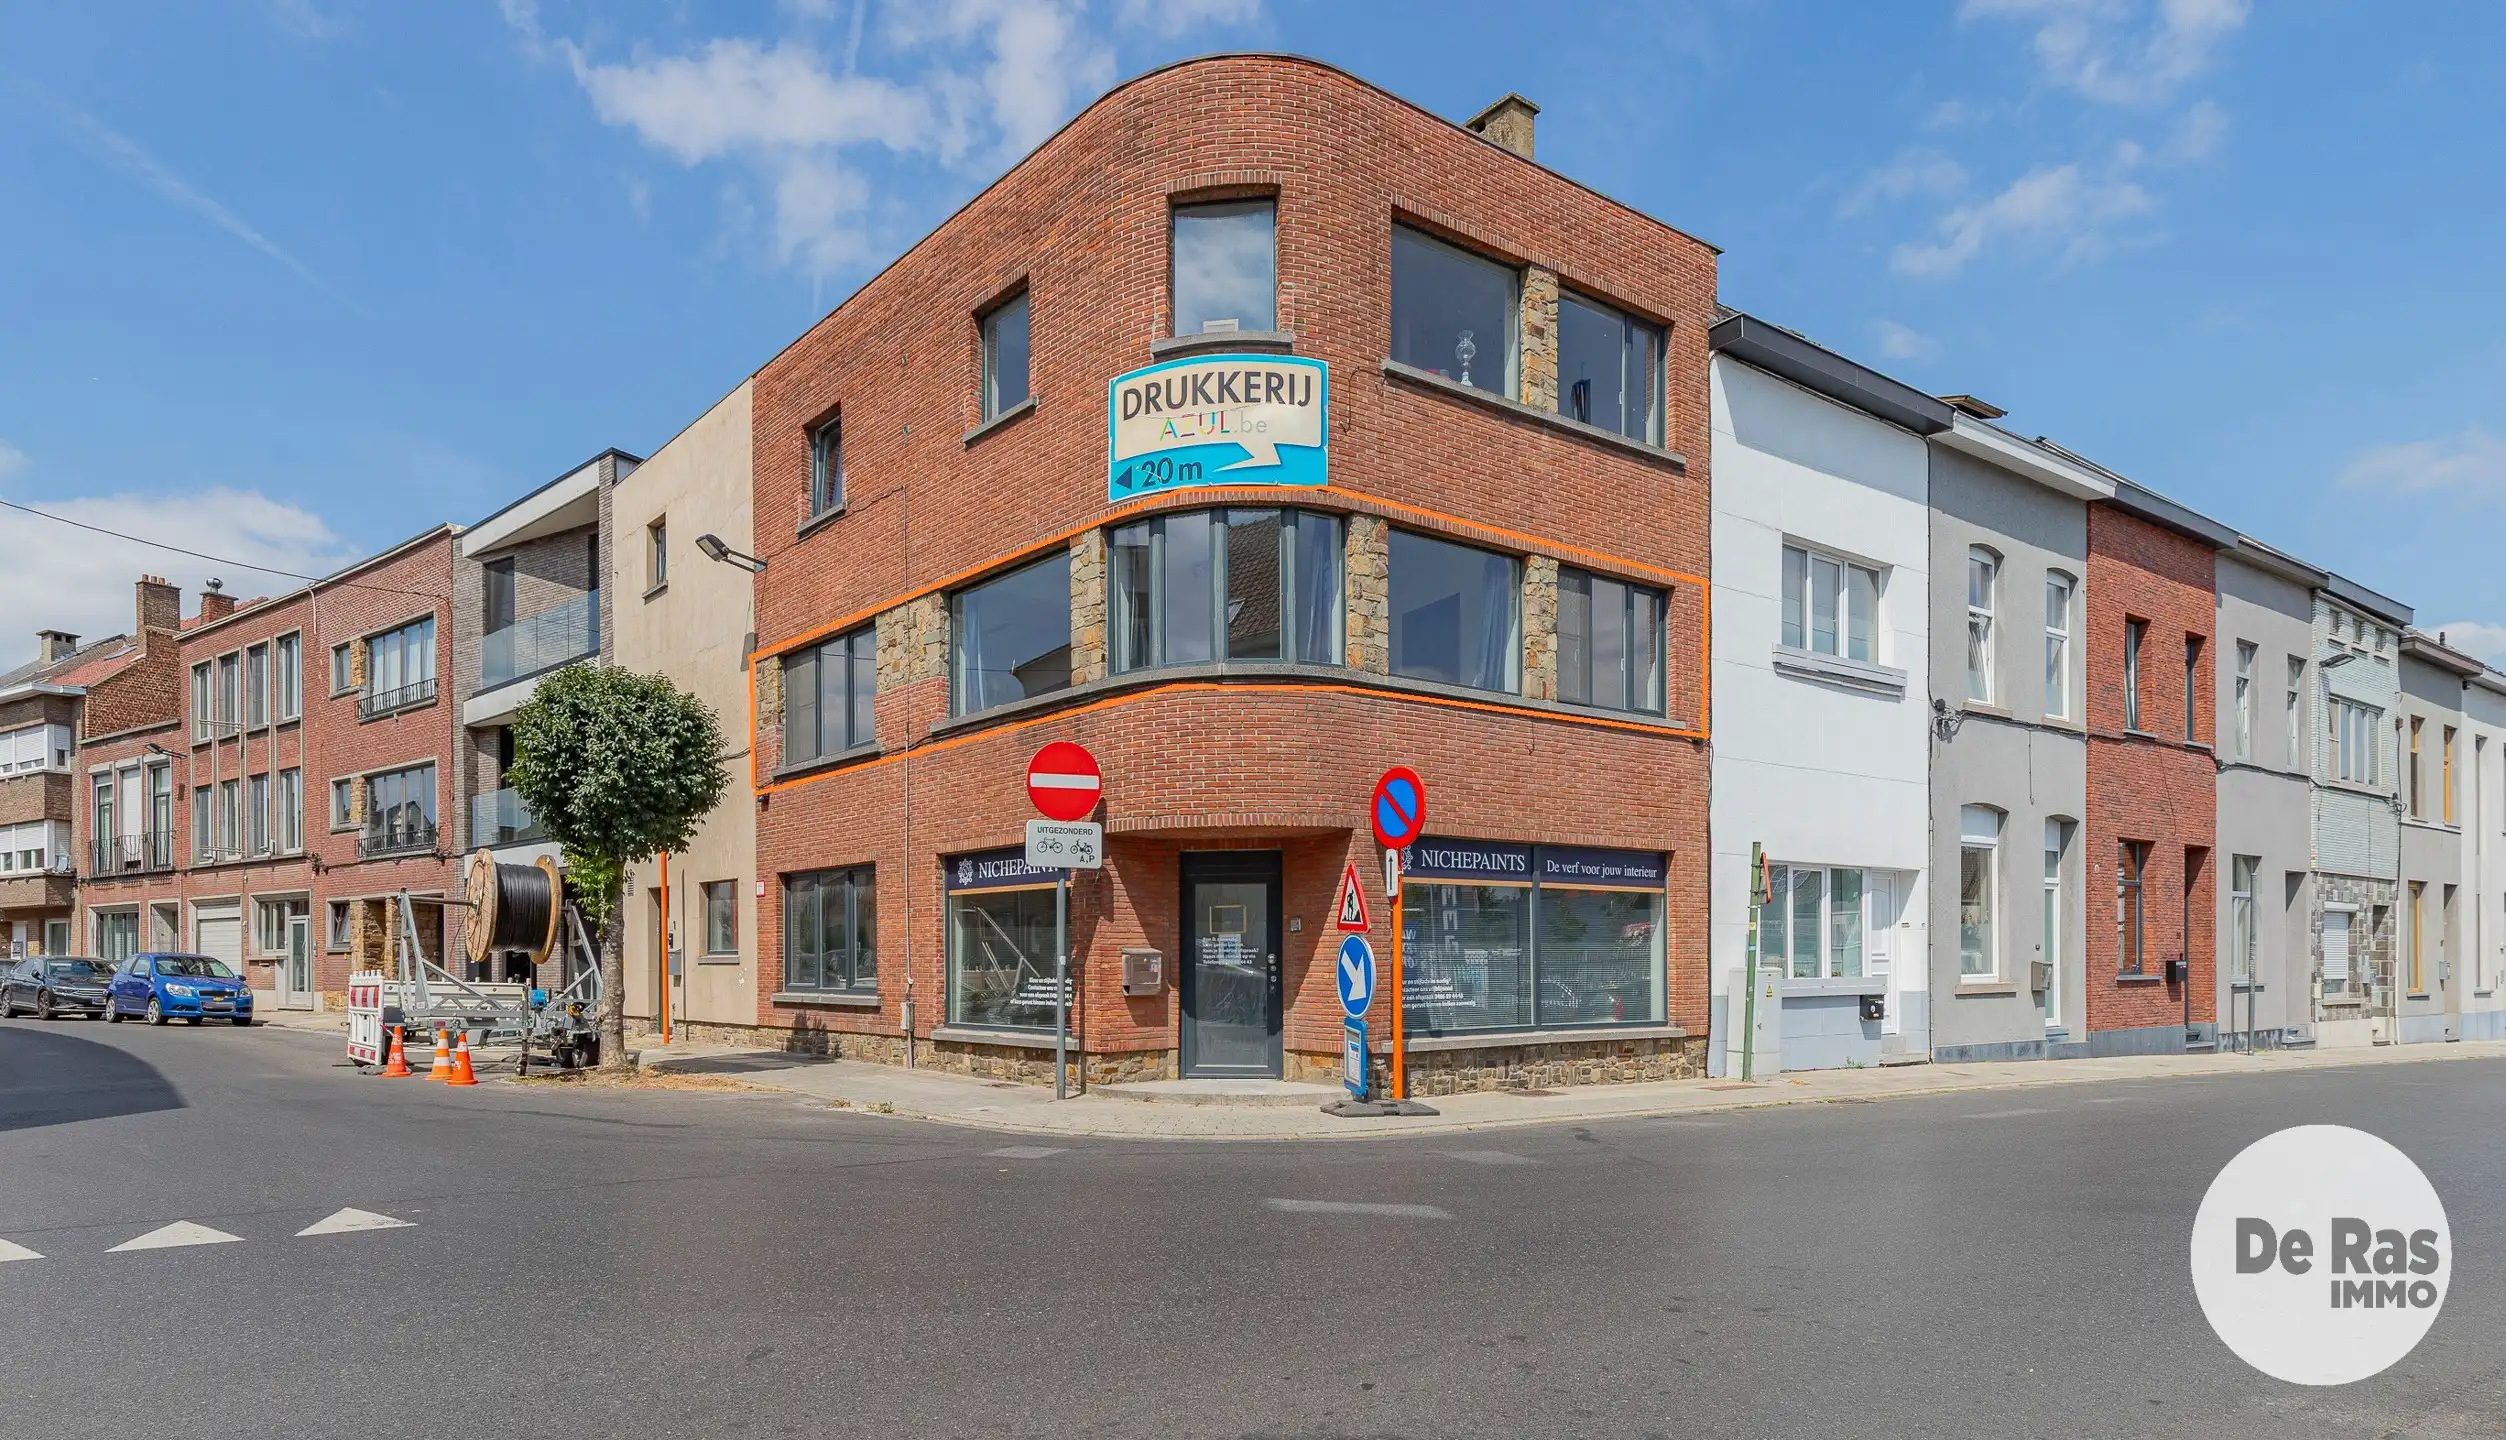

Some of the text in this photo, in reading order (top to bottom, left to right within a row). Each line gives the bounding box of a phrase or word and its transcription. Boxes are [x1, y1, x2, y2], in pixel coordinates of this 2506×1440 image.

[1123, 371, 1311, 421] DRUKKERIJ
[1141, 457, 1201, 487] 20 m
[1037, 826, 1094, 836] UITGEZONDERD
[978, 858, 1059, 879] NICHEPA
[1421, 849, 1525, 872] NICHEPAINTS
[1546, 859, 1658, 879] De verf voor jouw interieur
